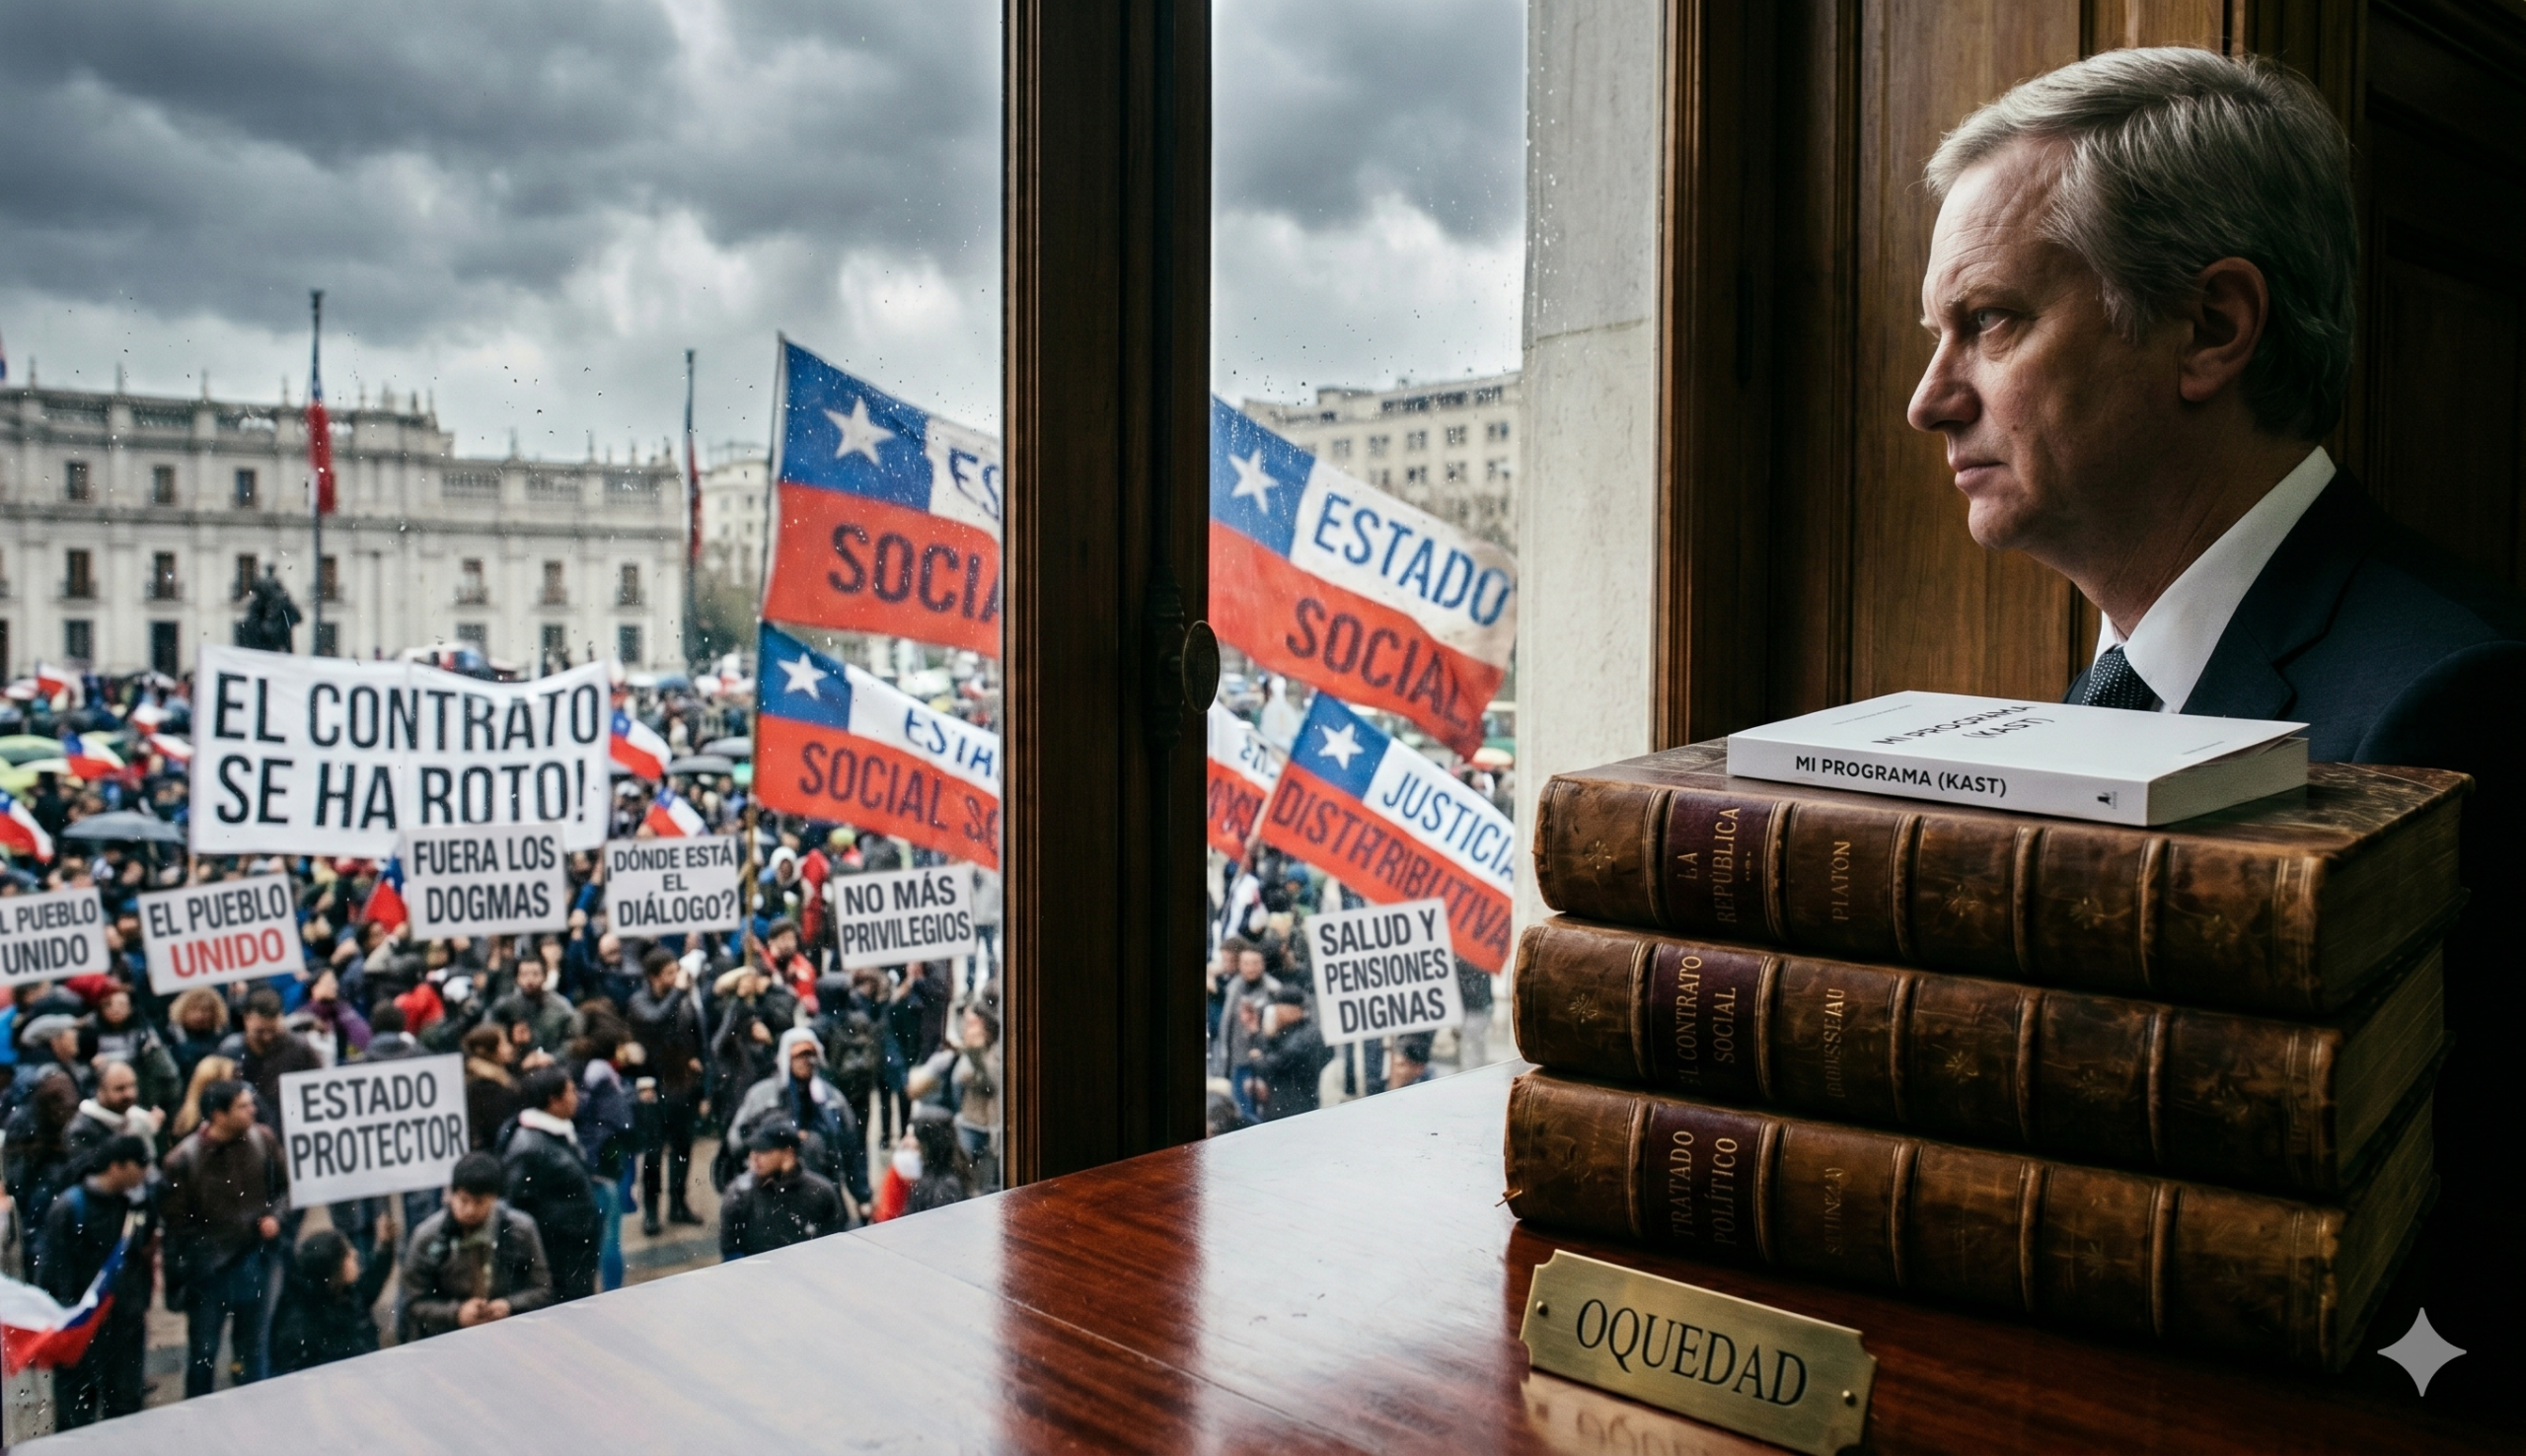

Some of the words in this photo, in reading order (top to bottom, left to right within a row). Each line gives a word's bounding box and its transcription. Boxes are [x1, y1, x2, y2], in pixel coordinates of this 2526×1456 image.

[1313, 492, 1513, 626] ESTADO
[1285, 597, 1469, 732] SOCIAL
[214, 673, 285, 744] EL
[310, 684, 599, 752] CONTRATO
[1872, 736, 1912, 745] MI
[1903, 706, 2037, 737] PROGRAMA
[1962, 718, 2055, 739] (KAST)
[216, 756, 293, 824] SE
[316, 763, 395, 830] HA
[420, 759, 585, 824] ROTO!
[797, 741, 948, 831] SOCIAL
[1796, 756, 1817, 772] MI
[1821, 759, 1932, 786] PROGRAMA
[1938, 771, 2007, 797] (KAST)
[413, 838, 498, 875] FUERA
[508, 837, 556, 870] LOS
[686, 838, 734, 868] ESTÁ
[1677, 852, 1698, 880] LA
[427, 882, 551, 923] DOGMAS
[662, 873, 690, 892] EL
[844, 882, 884, 916] NO
[894, 872, 956, 910] MÁS
[16, 897, 98, 933] PUEBLO
[147, 903, 182, 938] EL
[186, 884, 287, 932] PUEBLO
[618, 889, 735, 927] DIÁLOGO?
[1, 933, 89, 976] UNIDO
[170, 927, 285, 979] UNIDO
[842, 910, 971, 956] PRIVILEGIOS
[1319, 911, 1411, 957] SALUD
[1419, 908, 1437, 942] Y
[1324, 948, 1449, 995] PENSIONES
[1339, 987, 1447, 1034] DIGNAS
[1675, 956, 1702, 1061] CONTRATO
[1713, 987, 1737, 1063] SOCIAL
[300, 1070, 437, 1123] ESTADO
[290, 1113, 466, 1181] PROTECTOR
[1669, 1130, 1695, 1237] TRATADO
[1704, 1137, 1739, 1246] POLÍTICO
[1576, 1298, 1808, 1408] OQUEDAD
